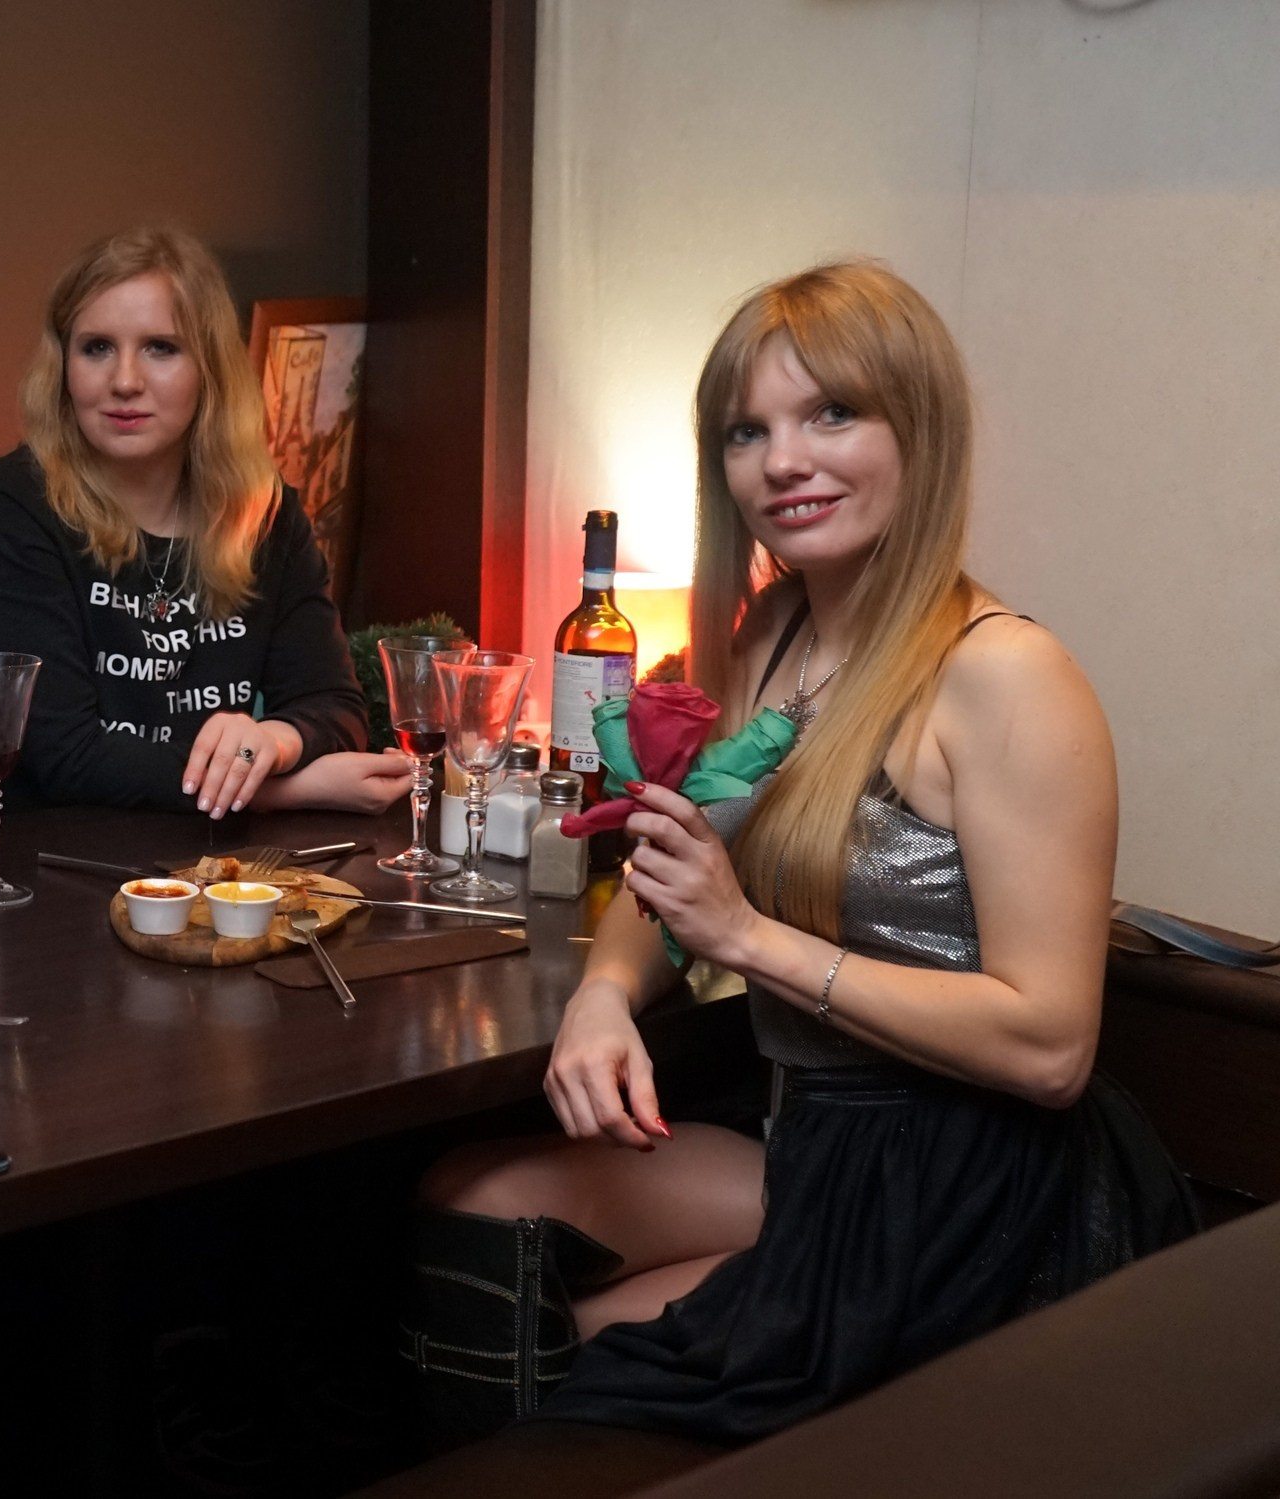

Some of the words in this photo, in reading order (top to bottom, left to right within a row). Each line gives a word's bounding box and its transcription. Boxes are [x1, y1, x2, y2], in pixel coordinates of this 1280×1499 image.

[124, 593, 196, 623] HAPY
[141, 629, 191, 653] FOR
[193, 616, 247, 644] HIS
[96, 651, 185, 681] OMEN
[166, 685, 221, 714] THIS
[229, 680, 251, 705] IS
